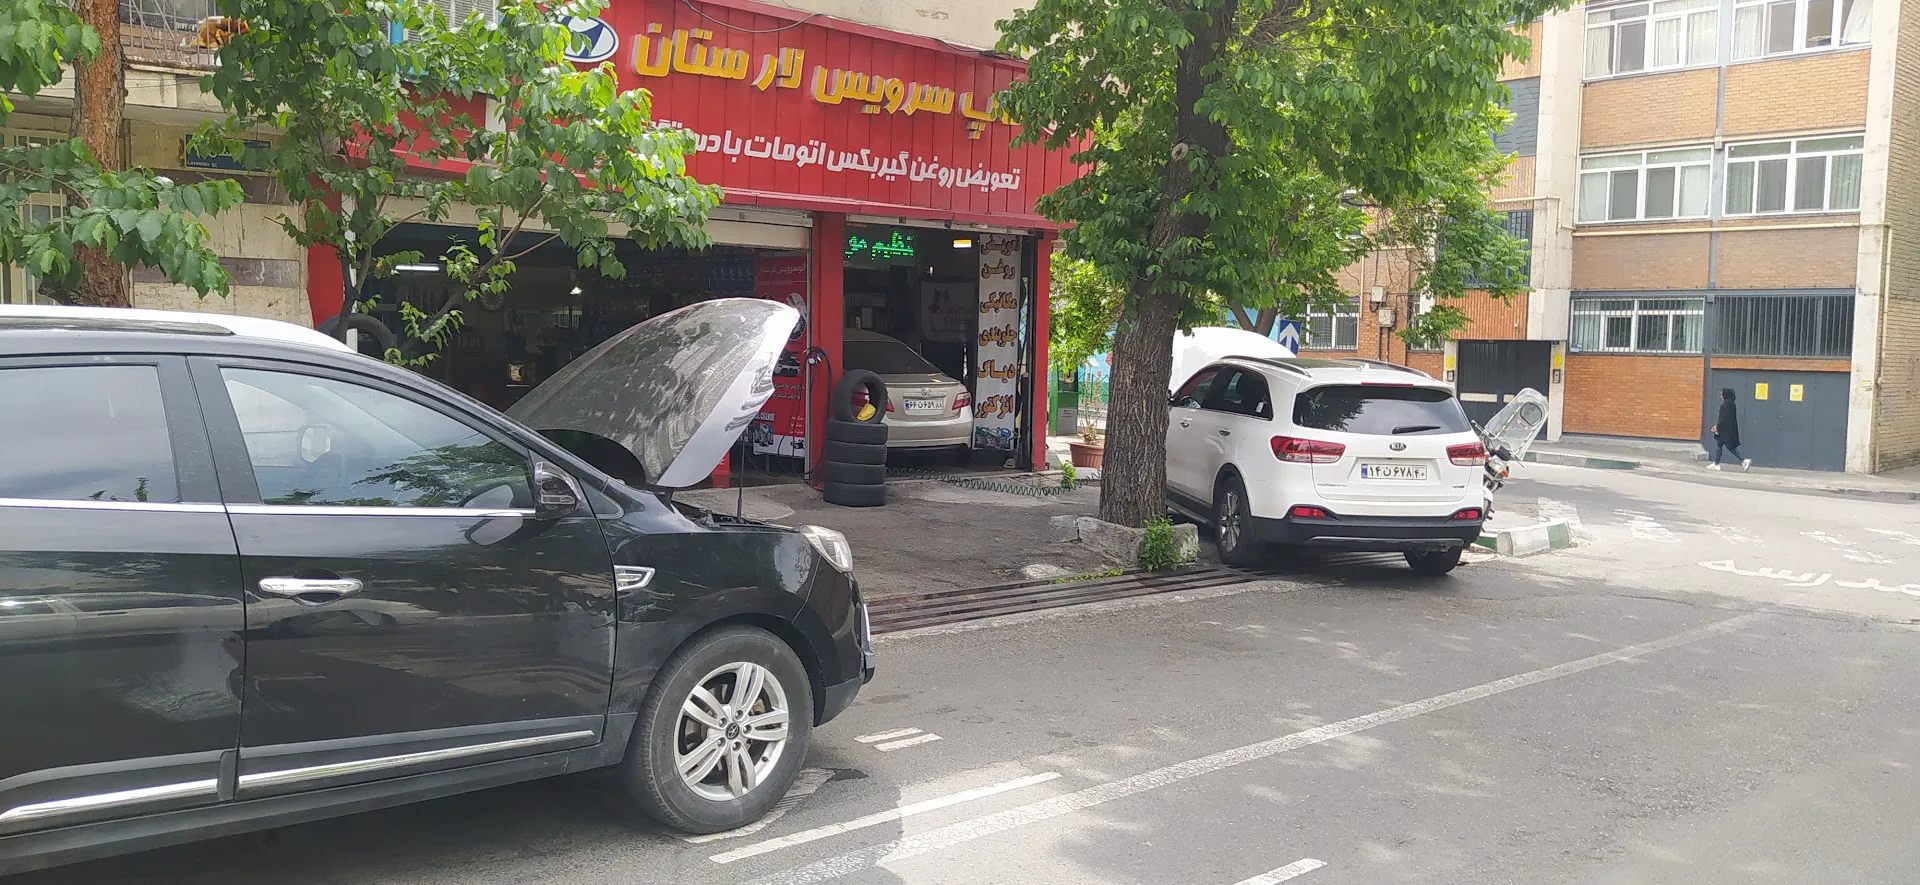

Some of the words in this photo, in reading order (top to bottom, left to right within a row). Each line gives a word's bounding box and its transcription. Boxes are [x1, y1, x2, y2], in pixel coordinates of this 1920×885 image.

[810, 65, 955, 116] سرویس
[723, 130, 743, 163] با
[743, 136, 827, 169] اتومات
[826, 148, 909, 182] گیربکس
[908, 155, 956, 188] روغن
[956, 162, 1021, 192] تعویض
[981, 234, 1020, 256] تعویض
[982, 258, 1015, 280] روغن
[979, 291, 1018, 314] مکانیکی
[979, 324, 1018, 347] جلوبندی
